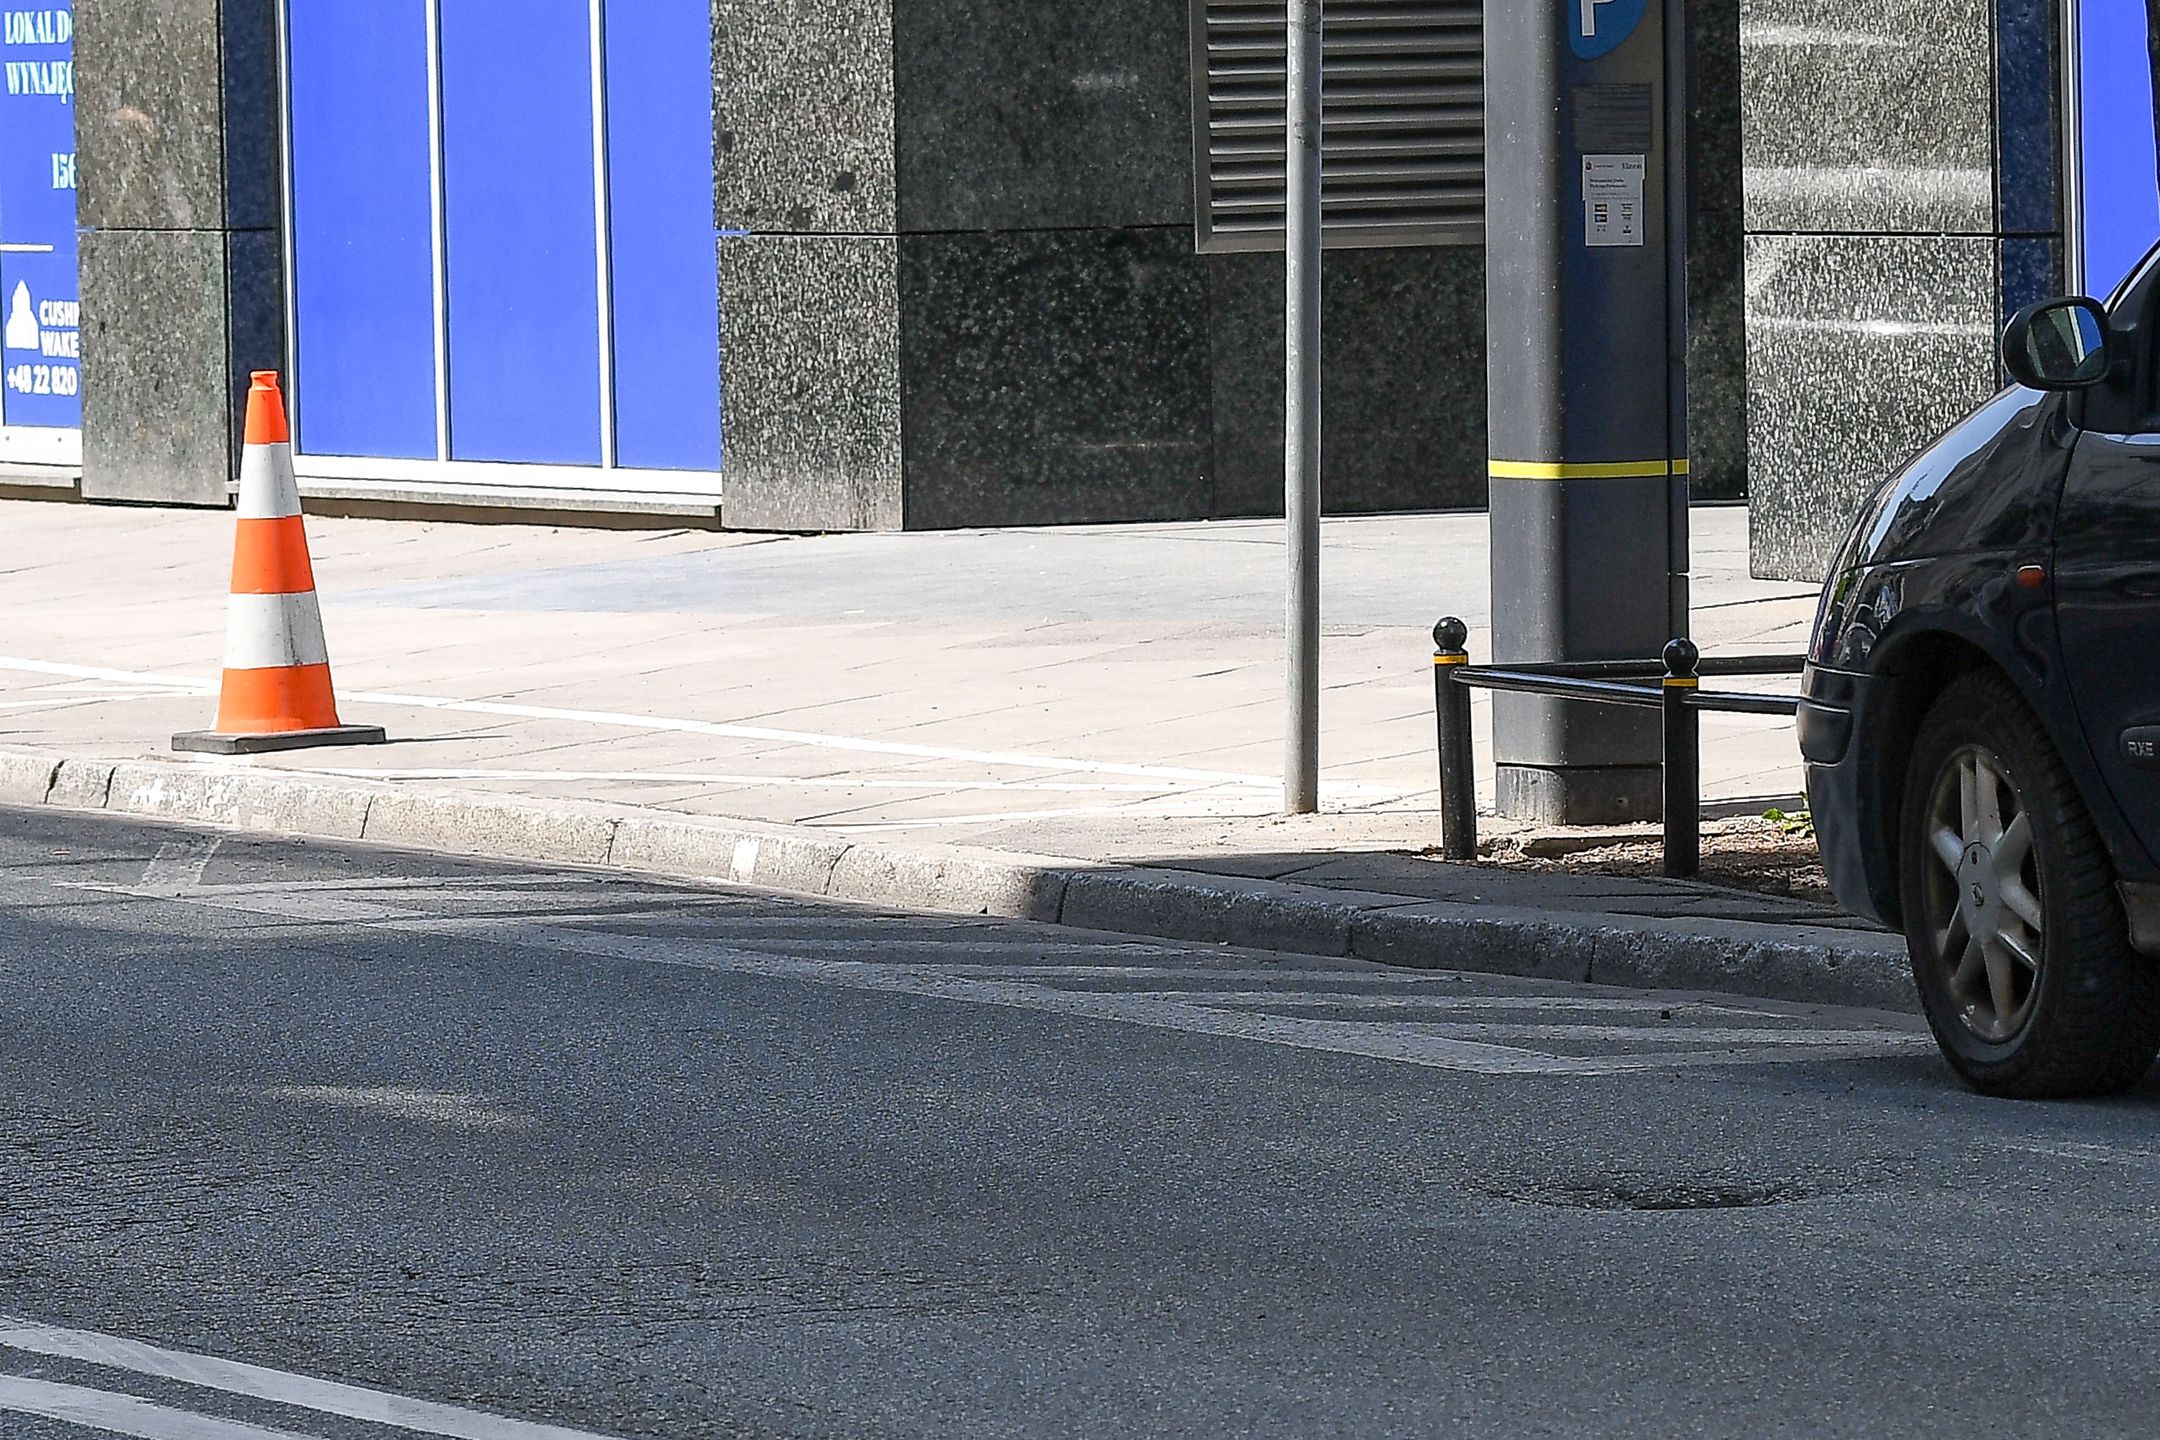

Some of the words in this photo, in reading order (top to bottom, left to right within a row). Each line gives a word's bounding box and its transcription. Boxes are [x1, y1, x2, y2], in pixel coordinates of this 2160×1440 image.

[4, 10, 56, 44] LOKAL
[32, 364, 51, 394] 22
[51, 365, 78, 396] 820
